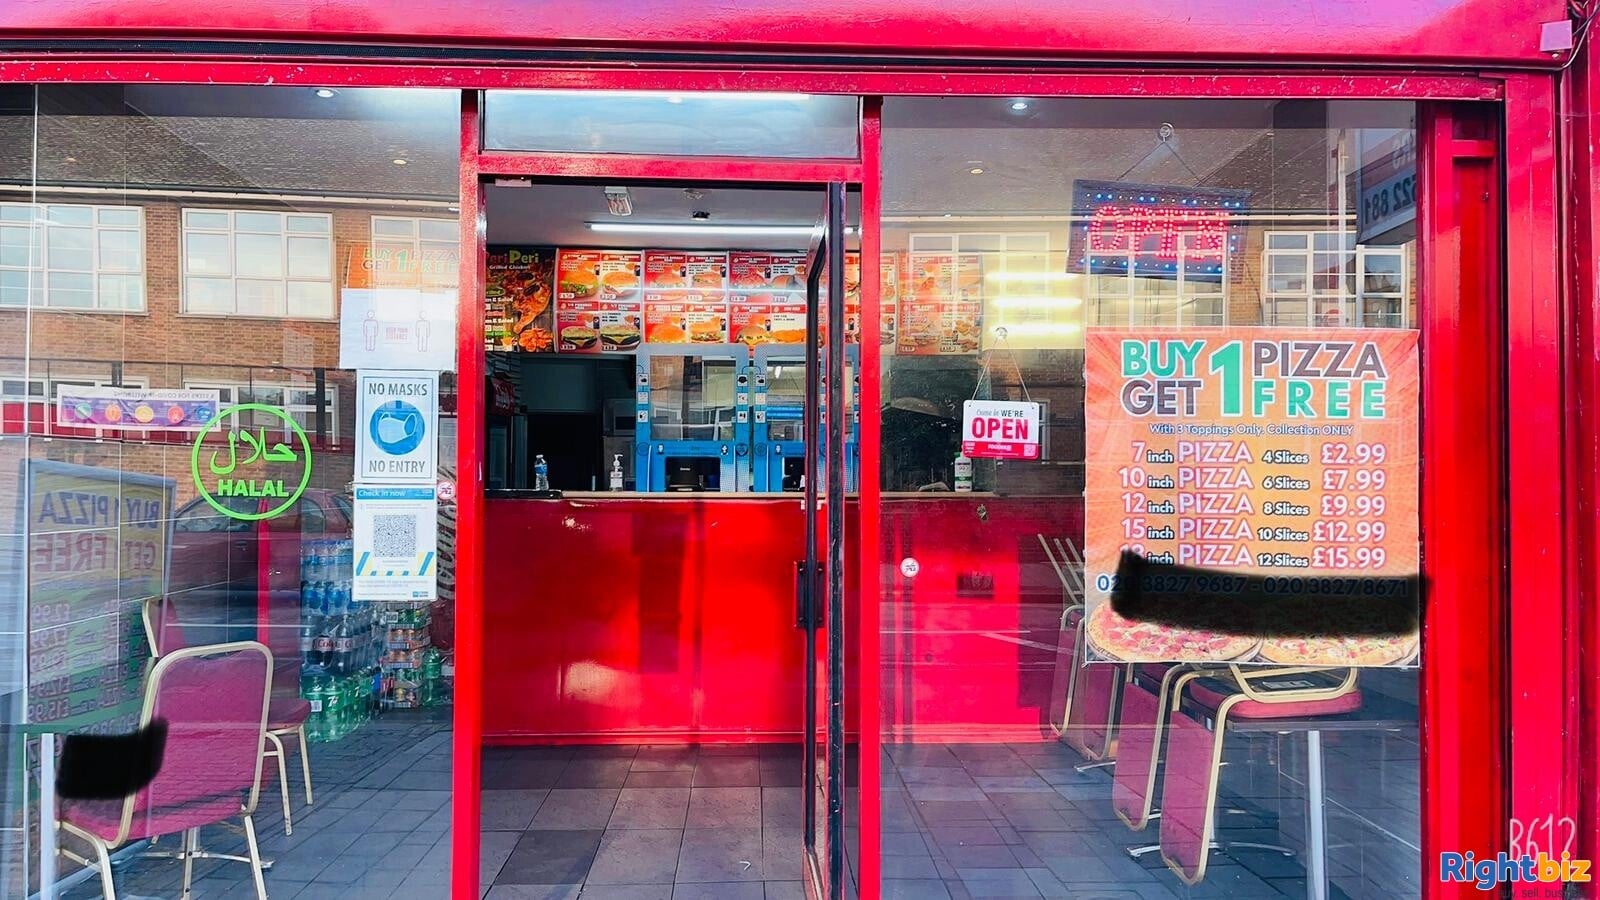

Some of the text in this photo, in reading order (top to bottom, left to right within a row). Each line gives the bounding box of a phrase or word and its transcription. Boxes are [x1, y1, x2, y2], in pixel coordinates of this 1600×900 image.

[1092, 204, 1230, 260] OPEN
[509, 250, 539, 263] Peri
[368, 383, 428, 396] NO MASKS
[1121, 340, 1386, 417] BUY 1 PIZZA
[1121, 380, 1386, 417] GET FREE
[971, 417, 1029, 440] OPEN
[1149, 423, 1175, 435] With
[1177, 424, 1184, 434] 3
[1185, 423, 1234, 437] Toppings
[1266, 424, 1320, 436] Collection
[1322, 425, 1354, 436] ONLY
[209, 426, 298, 475] حلال
[1131, 441, 1386, 465] 7 inch PIZZA 4 Slices £2.99
[368, 460, 426, 473] NO ENTRY
[217, 479, 289, 498] HALAL
[1118, 467, 1386, 491] 10 inch PIZZA 6 Slices £7.99
[358, 489, 381, 497] Check
[1121, 492, 1386, 517] 12 inch PIZZA 8 Slices £9.99
[1120, 518, 1386, 543] 15 inch PIZZA 10 Slices £12.99
[1147, 551, 1174, 566] inch
[1178, 544, 1255, 566] PIZZA
[1257, 554, 1274, 567] 12
[1274, 553, 1310, 568] Slices
[1312, 545, 1386, 569] £15.99
